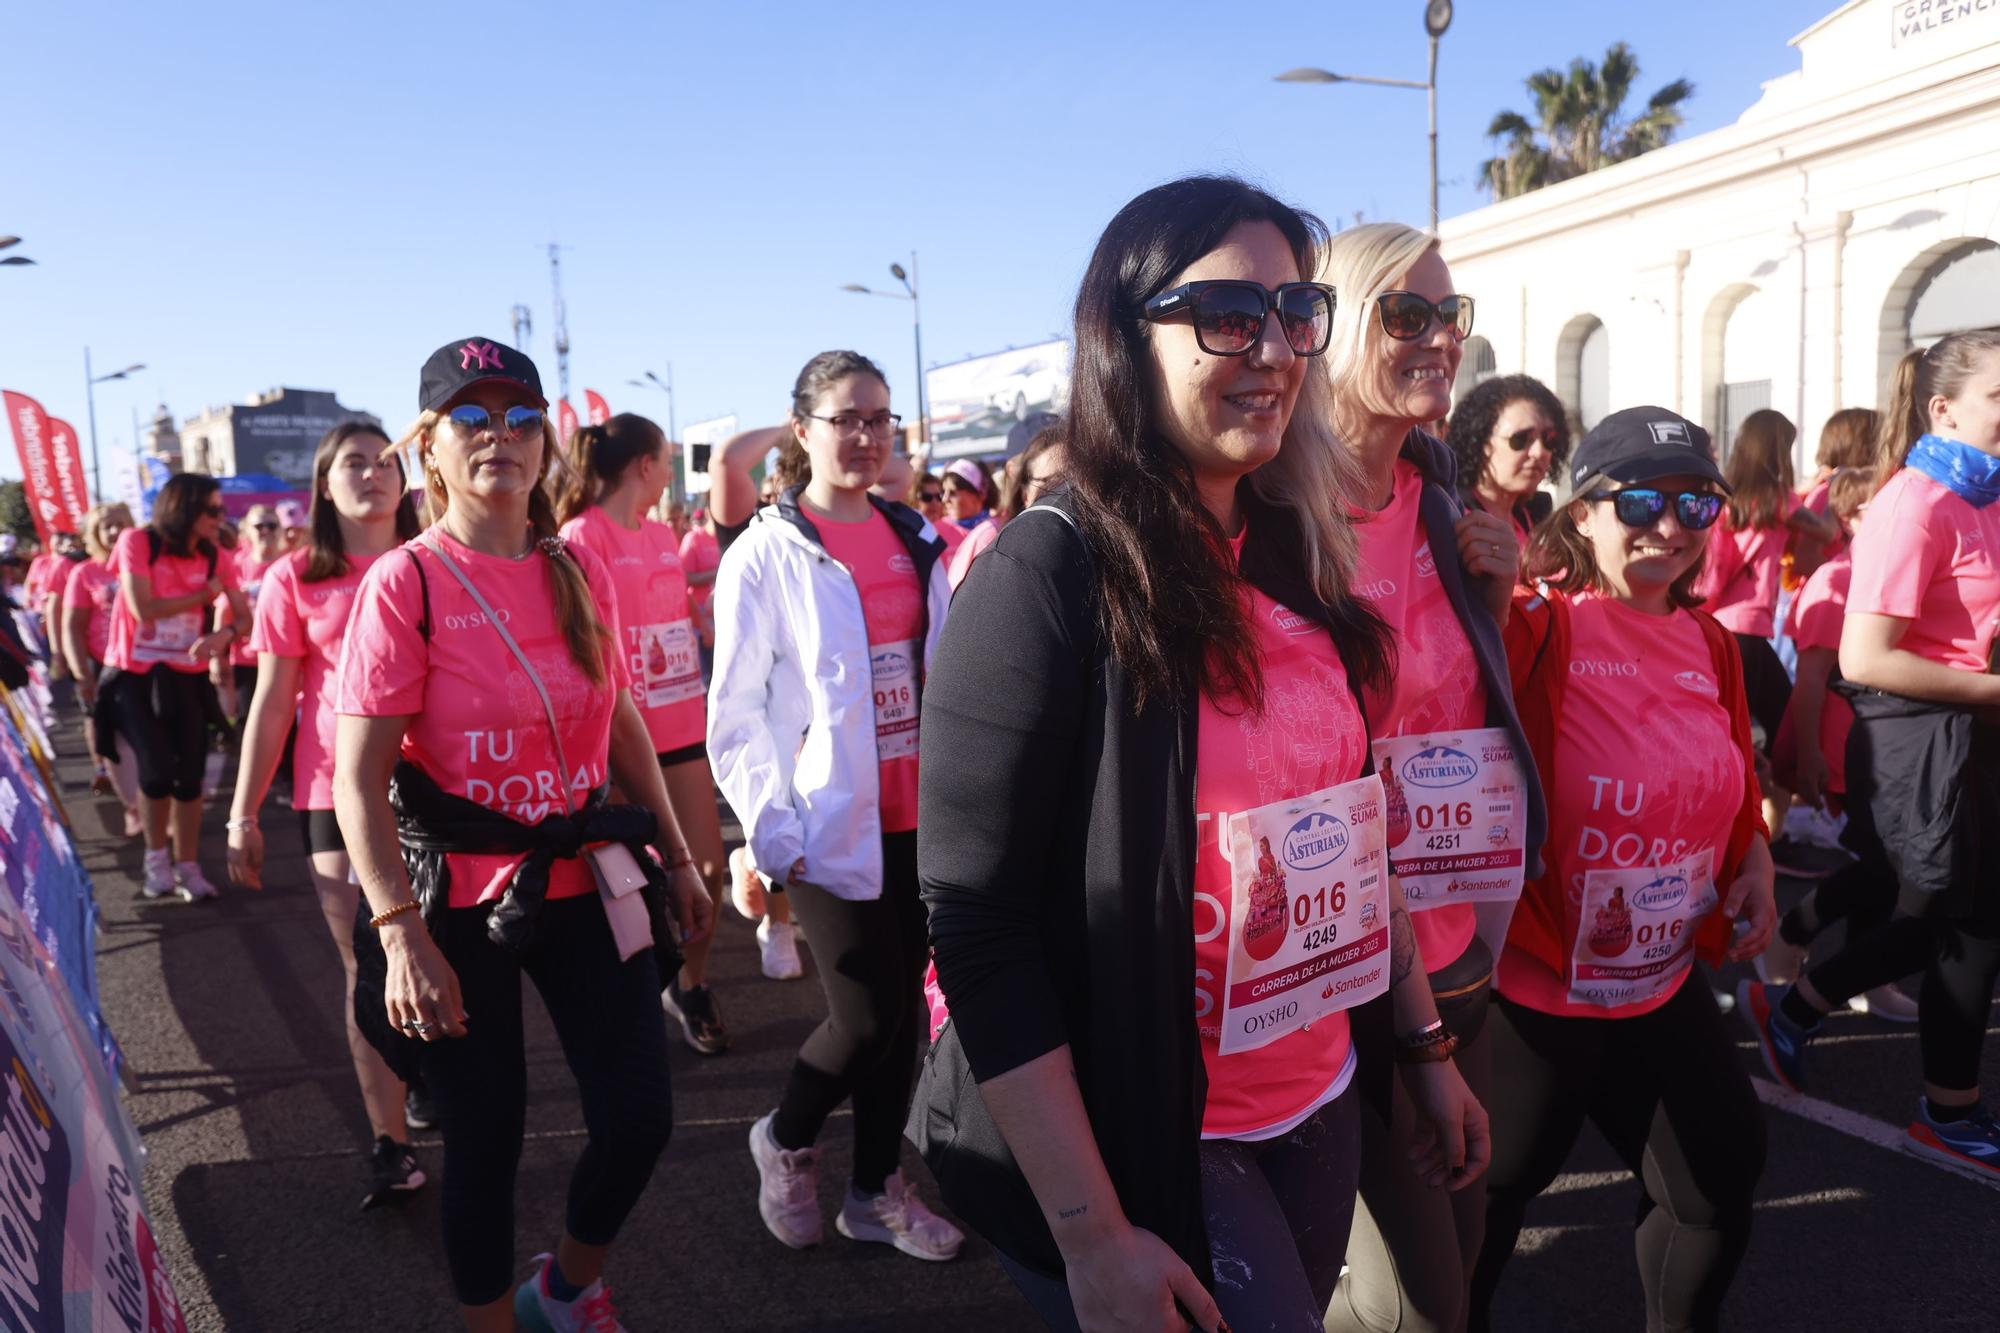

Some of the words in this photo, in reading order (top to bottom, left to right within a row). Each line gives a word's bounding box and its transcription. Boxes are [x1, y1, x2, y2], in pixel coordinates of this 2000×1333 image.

[459, 341, 505, 370] NY
[1569, 659, 1637, 677] OYSHO
[875, 686, 910, 707] 016
[464, 728, 514, 763] TU
[1483, 751, 1514, 763] SUMA
[1409, 762, 1473, 780] ASTURIANA
[1349, 805, 1357, 813] TU
[1357, 799, 1378, 811] DORSAL
[1588, 774, 1643, 817] TU
[1351, 807, 1378, 826] SUMA
[1416, 802, 1473, 830] 016
[1289, 831, 1346, 863] ASTURIANA
[1426, 833, 1461, 850] 4251
[1424, 861, 1438, 871] DE
[1441, 860, 1452, 869] LA
[1455, 857, 1486, 868] MUJER
[1490, 855, 1511, 866] 2023
[1460, 878, 1512, 892] Santander
[1294, 881, 1346, 927] 016
[1303, 923, 1337, 951] 4249
[1636, 918, 1684, 944] 016
[1643, 943, 1672, 960] 4250
[1252, 970, 1300, 997] CARRERA
[1302, 966, 1314, 980] DE
[1315, 960, 1327, 973] LA
[1329, 947, 1361, 968] MUJER
[1362, 937, 1379, 955] 2023
[1335, 966, 1382, 996] Santander
[1586, 988, 1635, 1000] OYSHO
[1244, 1001, 1299, 1035] OYSHO
